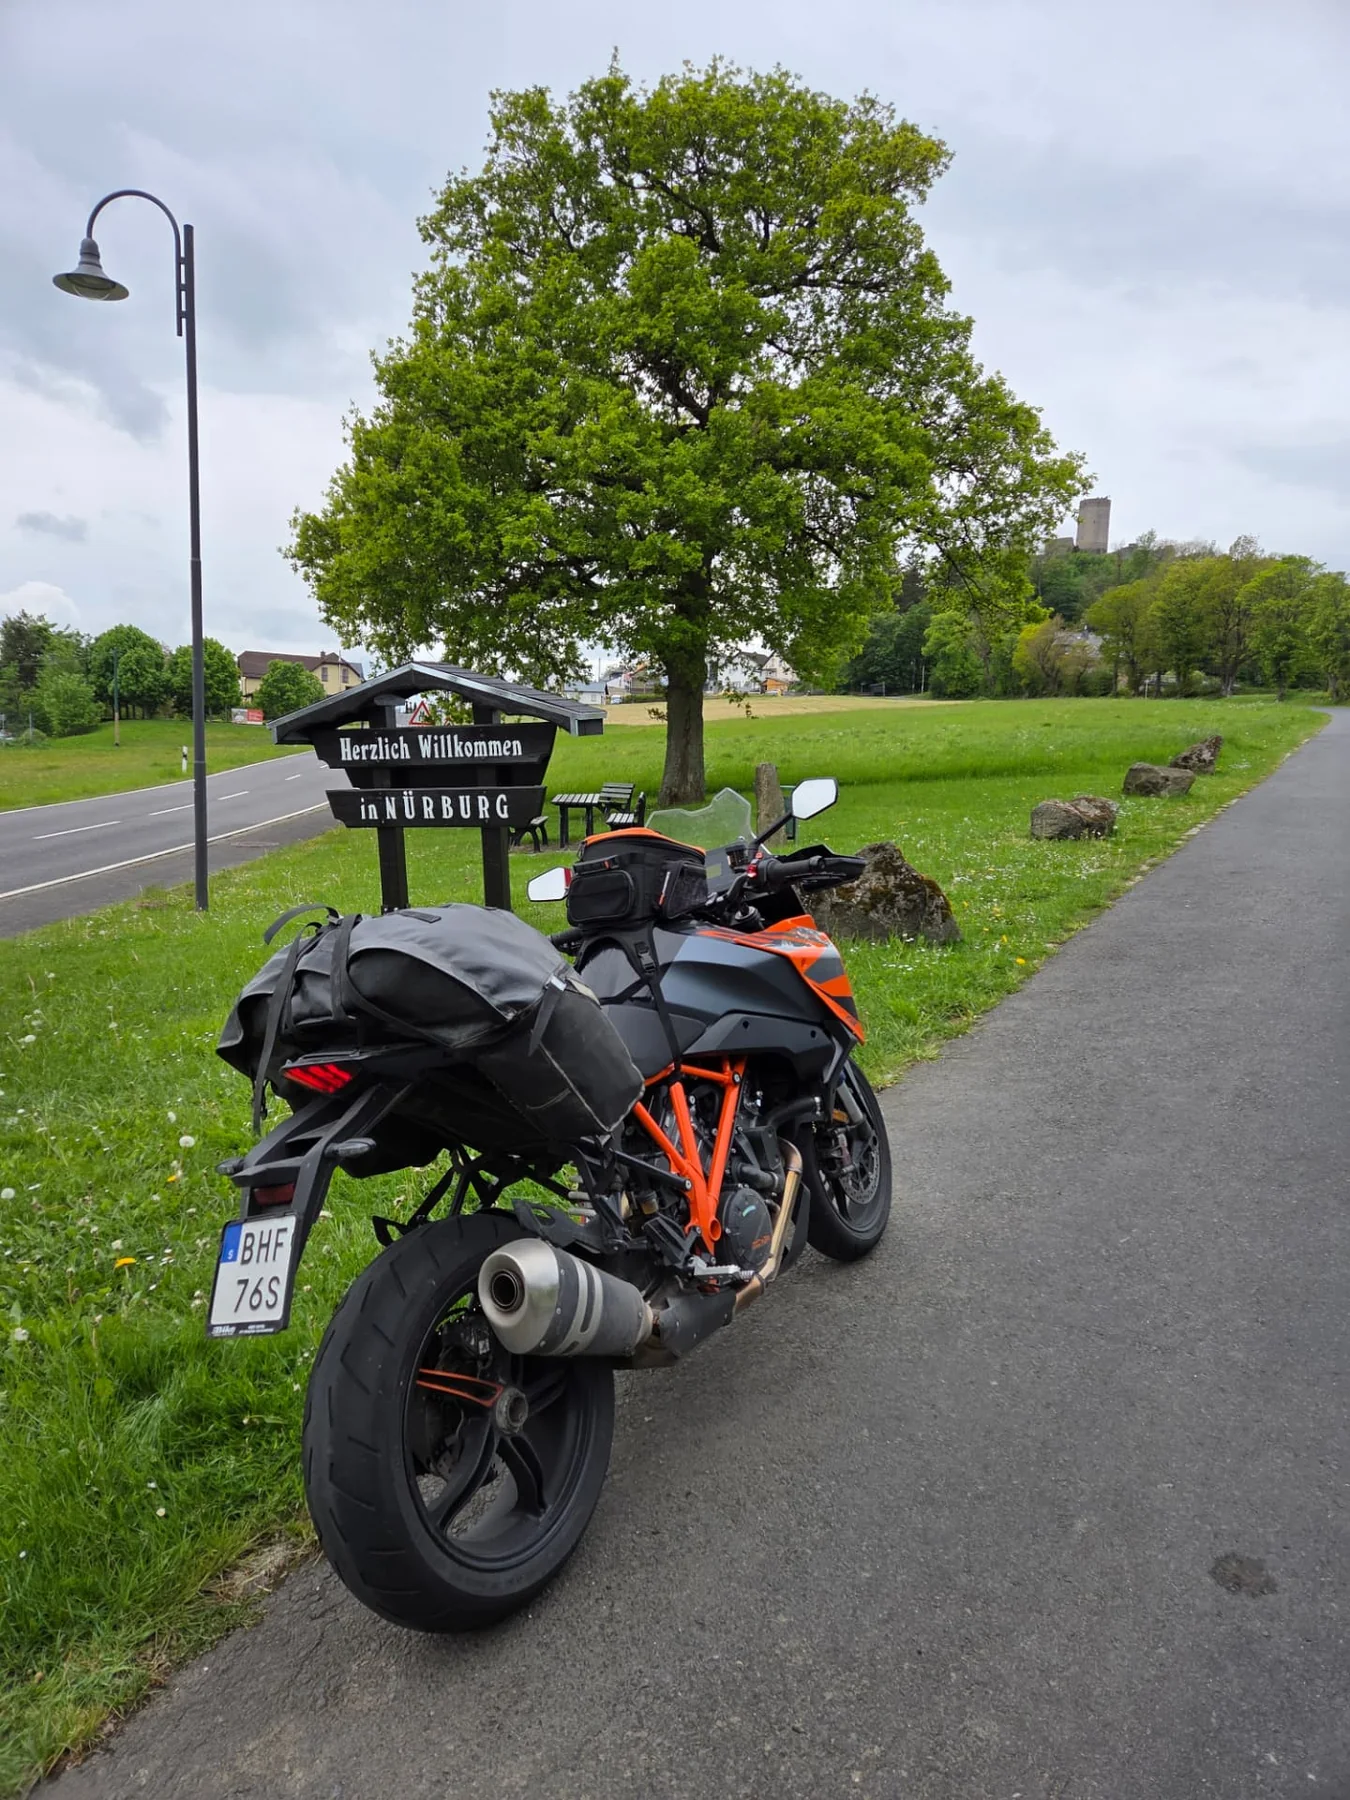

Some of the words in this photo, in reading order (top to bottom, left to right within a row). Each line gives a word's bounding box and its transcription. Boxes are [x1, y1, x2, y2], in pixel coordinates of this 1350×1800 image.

[340, 736, 411, 761] Herzlich
[418, 734, 522, 759] Willkommen
[361, 797, 378, 820] in
[385, 790, 509, 820] NÜRBURG
[228, 1249, 234, 1260] S
[241, 1227, 288, 1265] BHF
[234, 1276, 280, 1313] 76S
